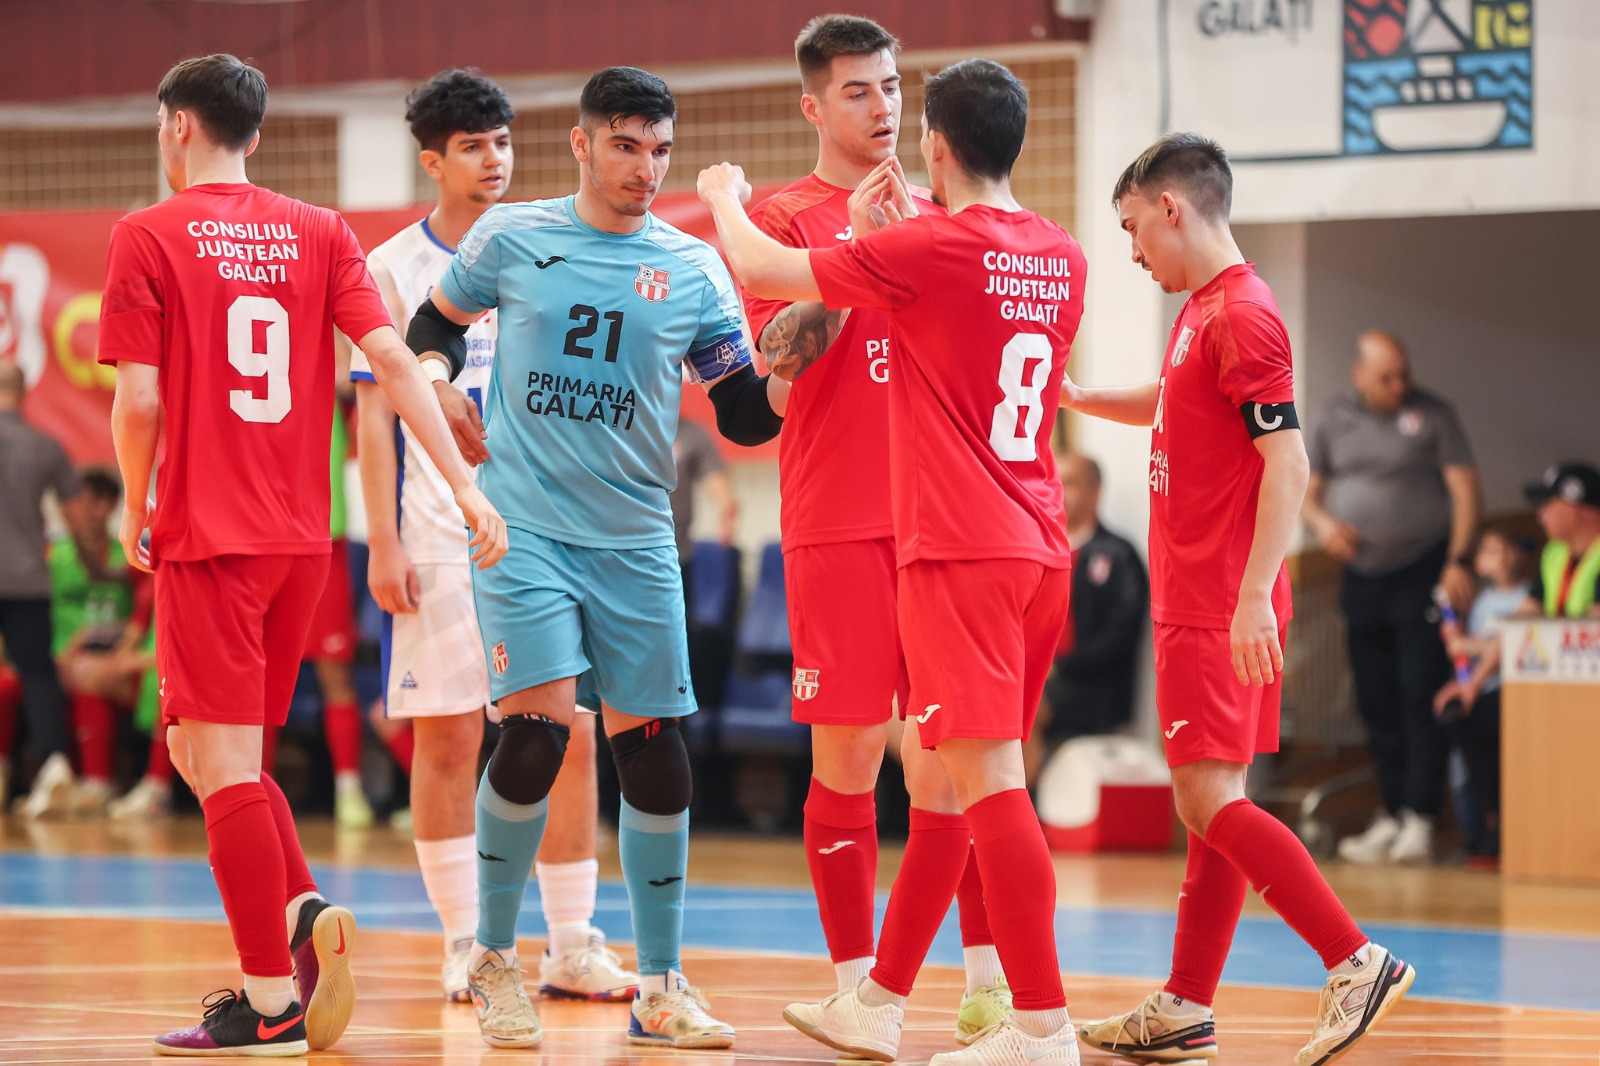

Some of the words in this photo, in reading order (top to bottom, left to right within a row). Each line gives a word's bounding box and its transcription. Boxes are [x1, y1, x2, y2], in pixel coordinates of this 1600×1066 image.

[187, 220, 298, 241] CONSILIUL
[983, 251, 1071, 277] CONSILIUL
[563, 303, 624, 363] 21
[227, 295, 292, 424] 9
[989, 332, 1053, 462] 8
[1253, 402, 1283, 431] C
